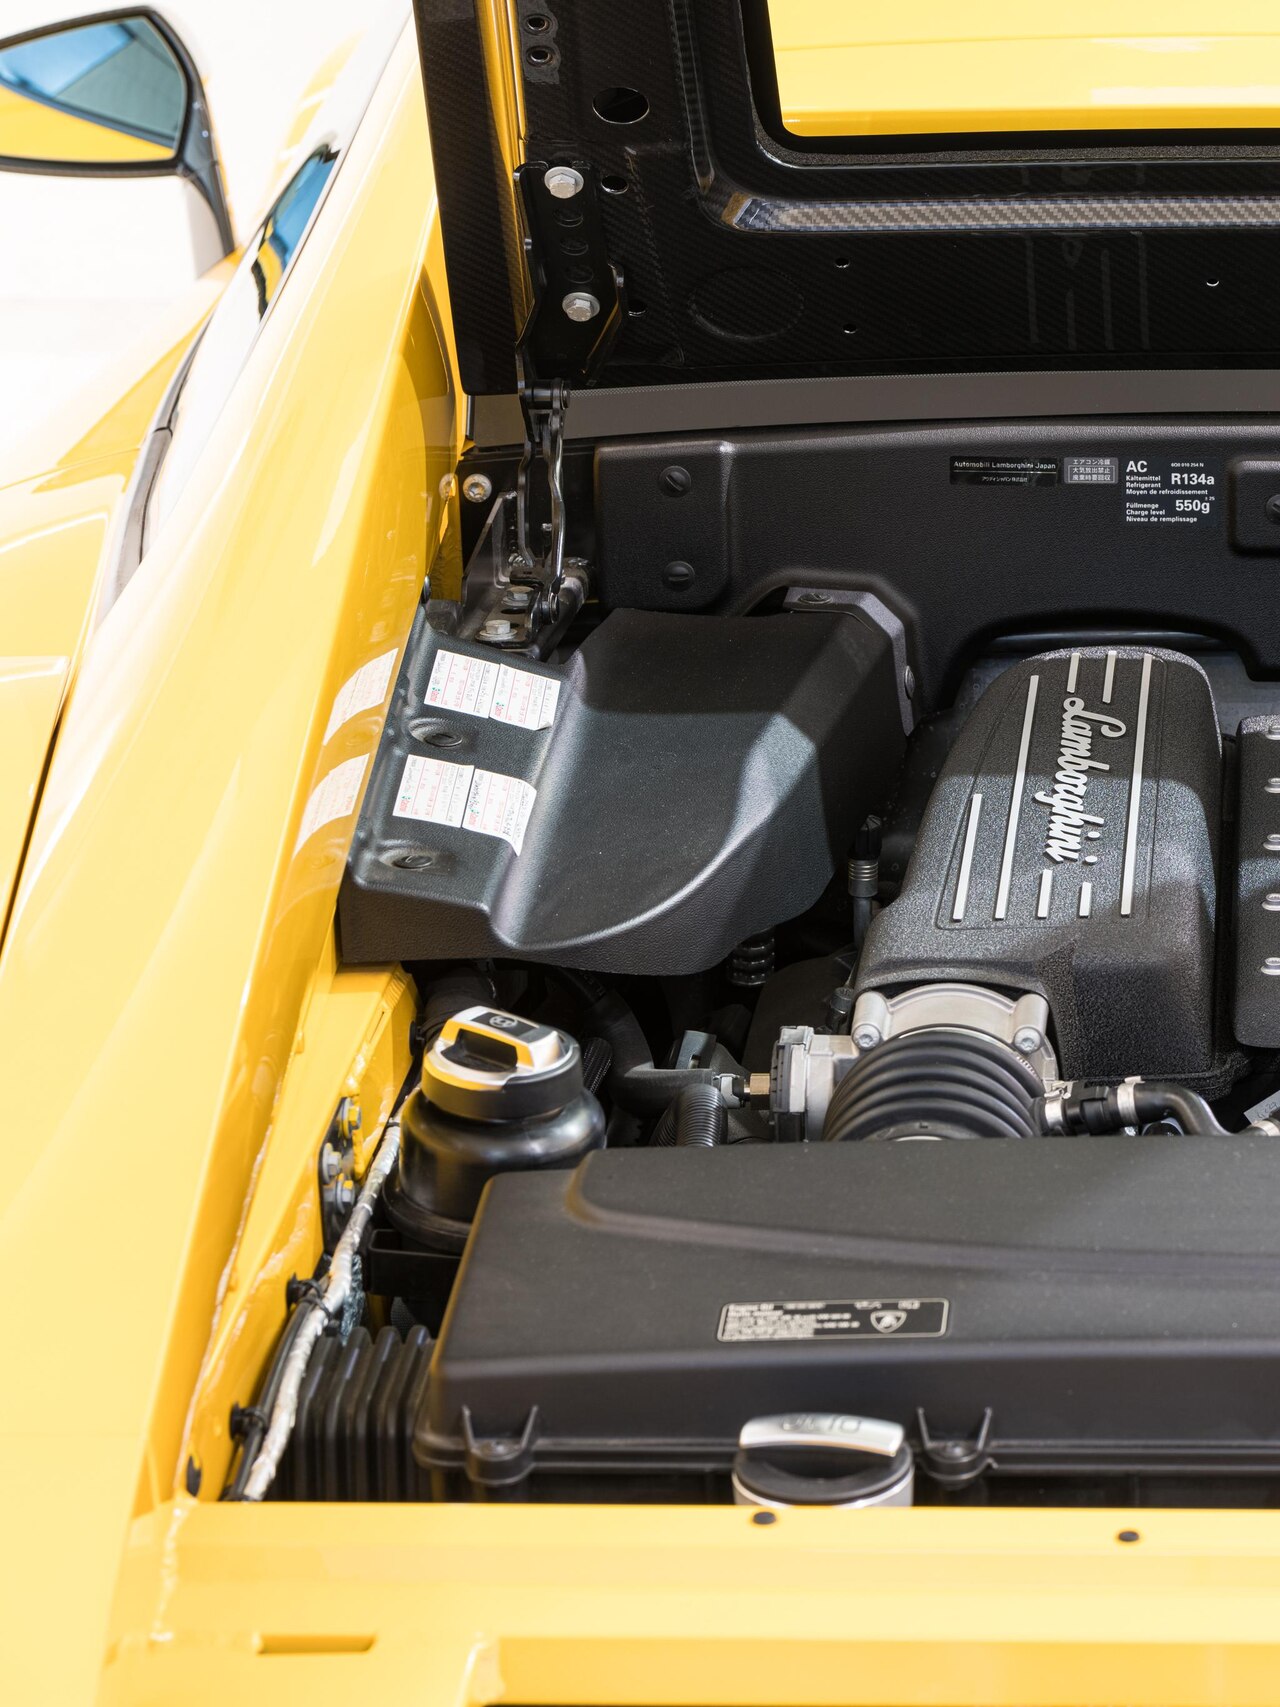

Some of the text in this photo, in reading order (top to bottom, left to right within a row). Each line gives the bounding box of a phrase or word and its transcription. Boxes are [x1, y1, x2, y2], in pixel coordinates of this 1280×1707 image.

[991, 462, 1034, 470] Lamborghini
[1035, 462, 1056, 470] Japan
[1126, 460, 1148, 473] AC
[1171, 473, 1215, 485] R134a
[1175, 500, 1210, 514] 550g
[1035, 697, 1127, 864] Lamborghini
